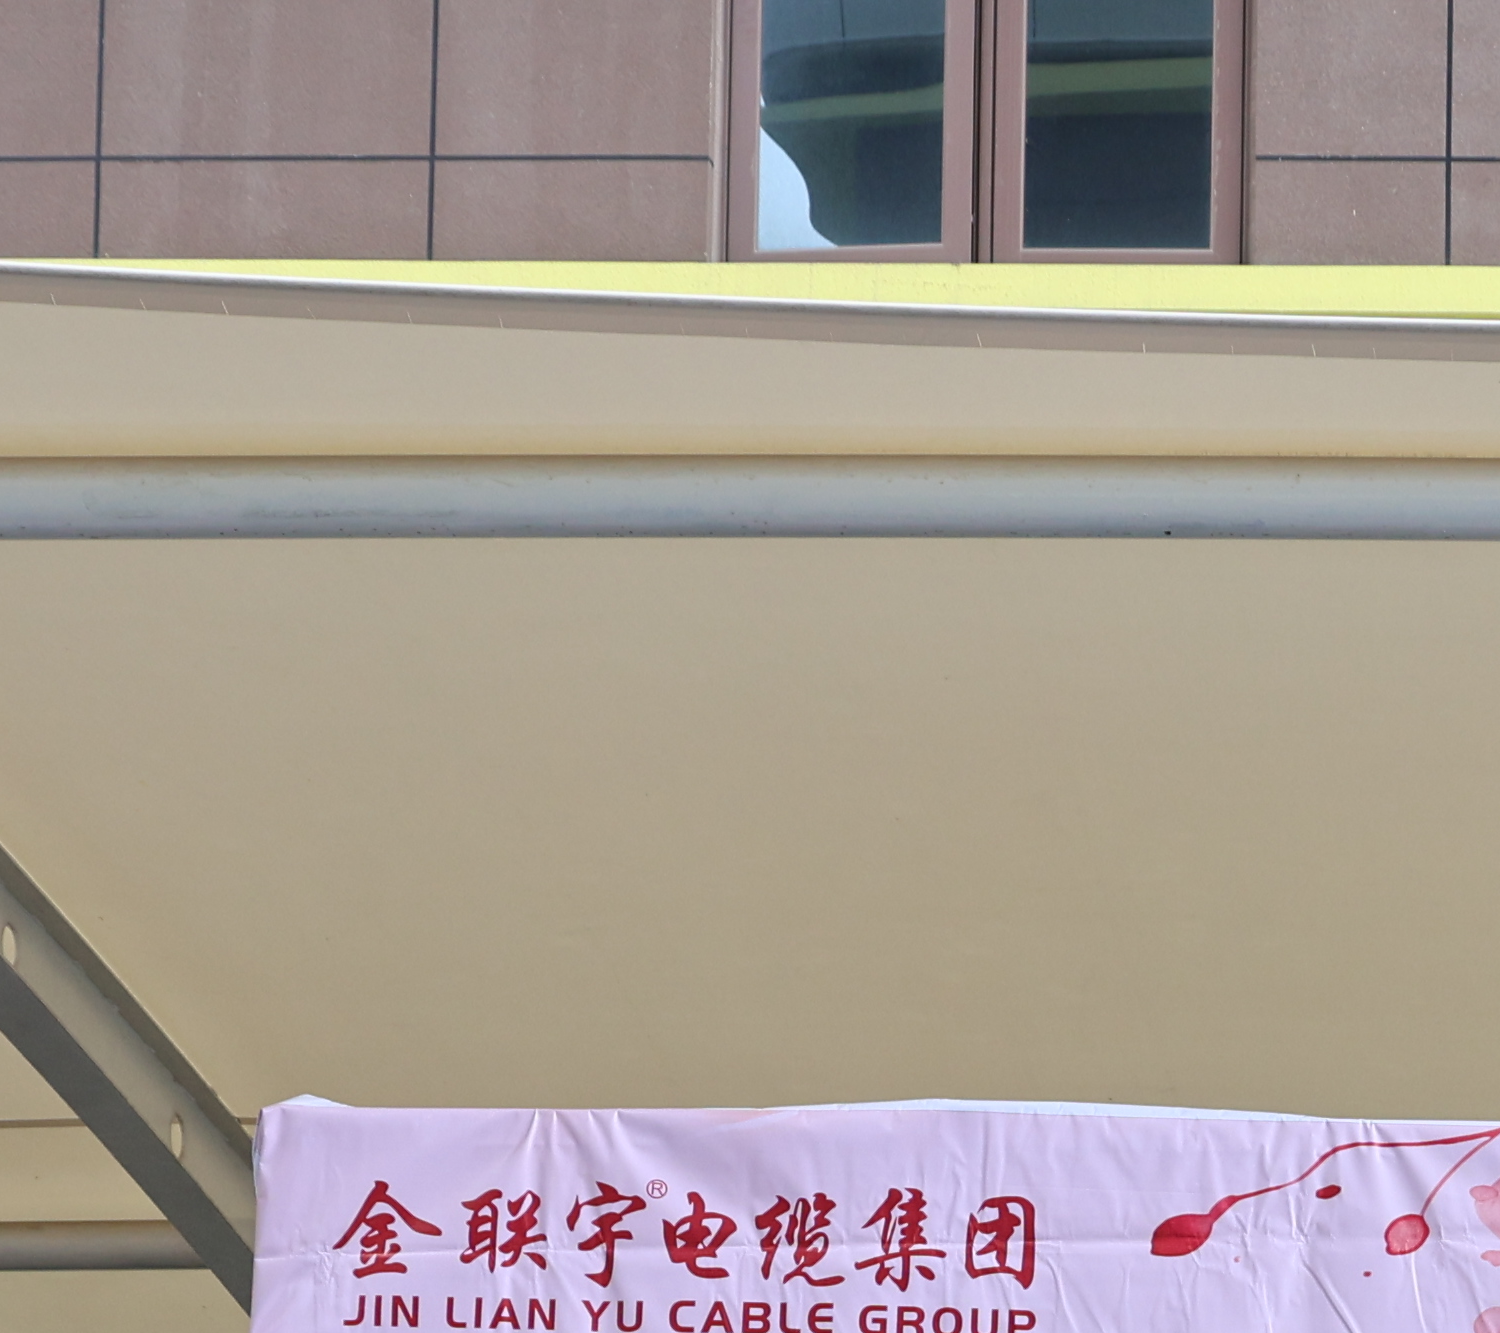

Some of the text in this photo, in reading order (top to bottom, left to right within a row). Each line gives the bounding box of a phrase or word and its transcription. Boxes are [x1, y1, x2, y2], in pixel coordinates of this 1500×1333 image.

[342, 1294, 419, 1328] JIN
[445, 1296, 557, 1331] LIAN
[582, 1299, 644, 1332] YU
